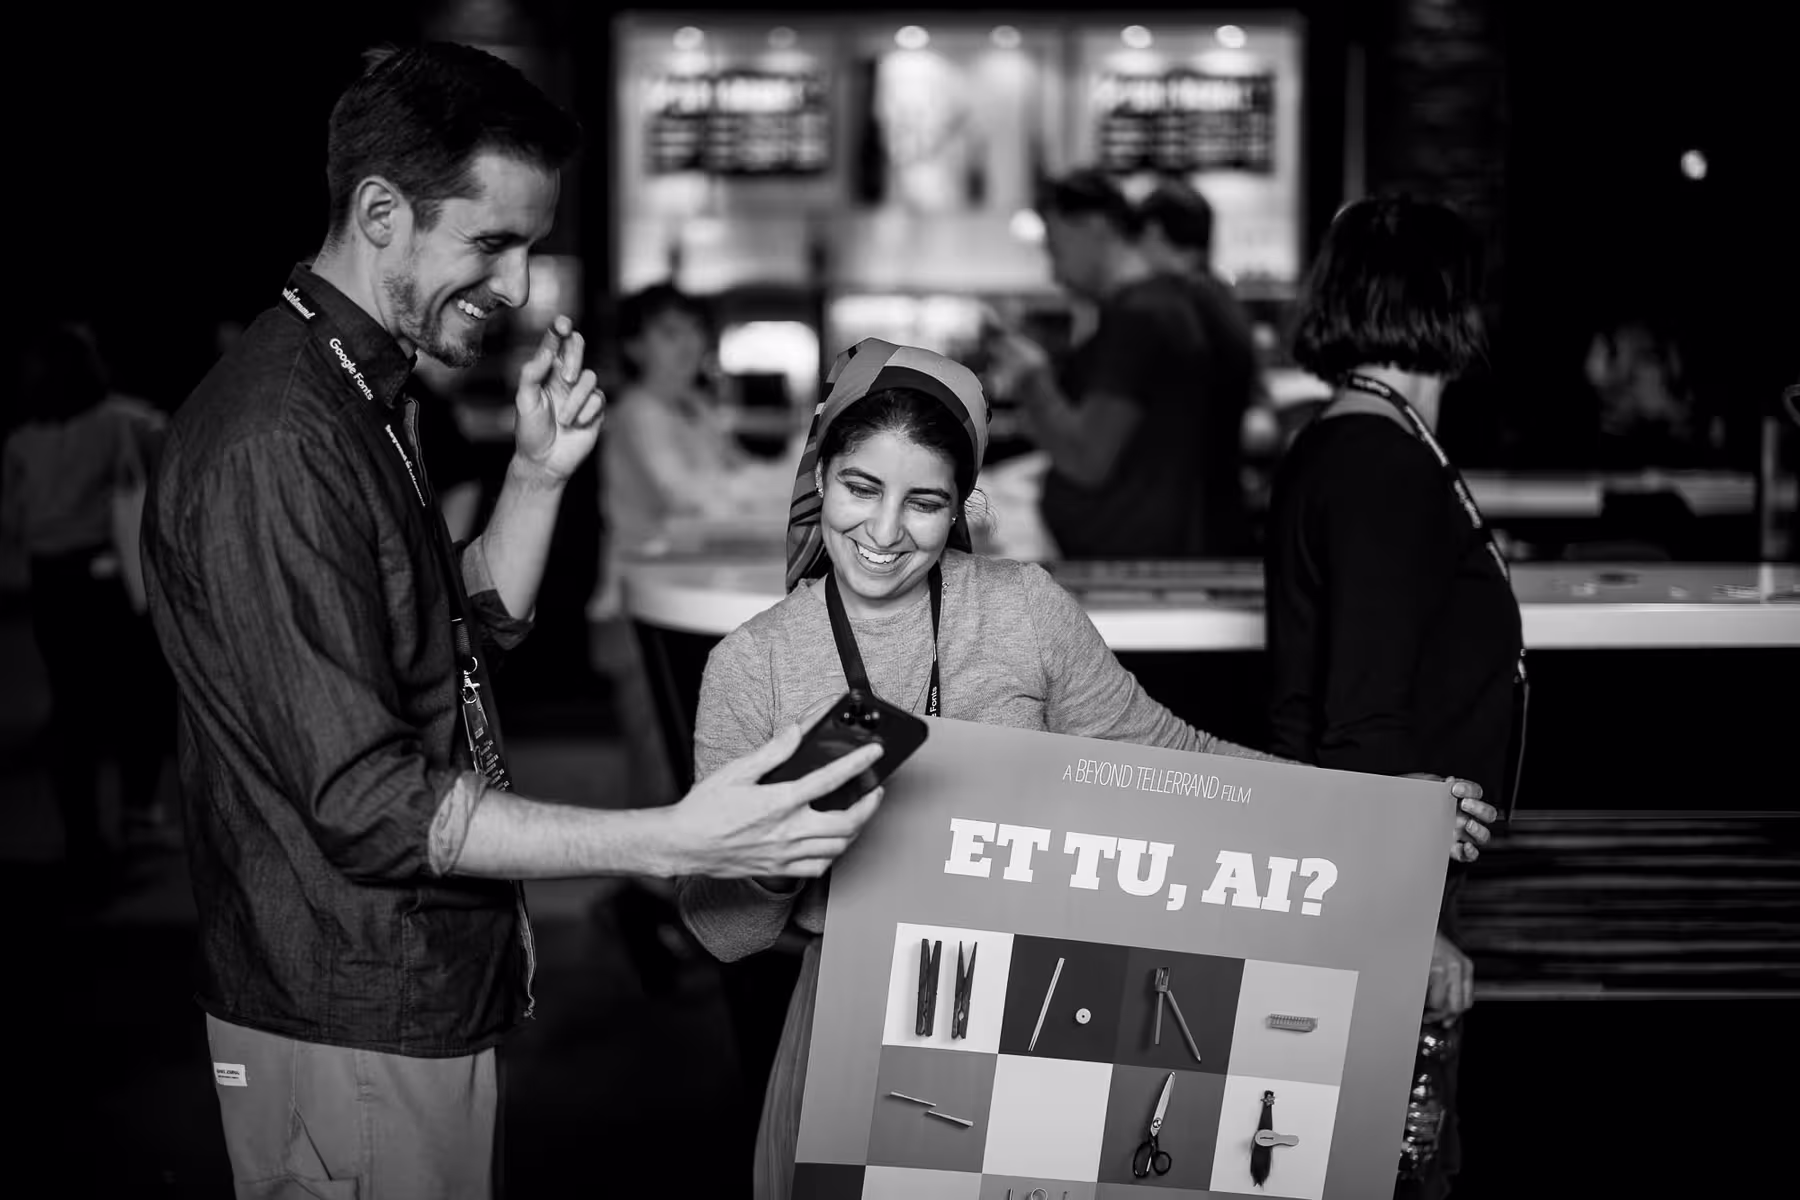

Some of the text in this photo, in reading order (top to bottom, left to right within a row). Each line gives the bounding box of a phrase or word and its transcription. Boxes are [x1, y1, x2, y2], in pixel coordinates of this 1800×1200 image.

[329, 338, 374, 400] Google Fonts
[929, 686, 938, 713] Fonts
[1062, 758, 1252, 804] A BEYOND TELLERRAND FILM
[943, 817, 1338, 917] ET TU, AI?
